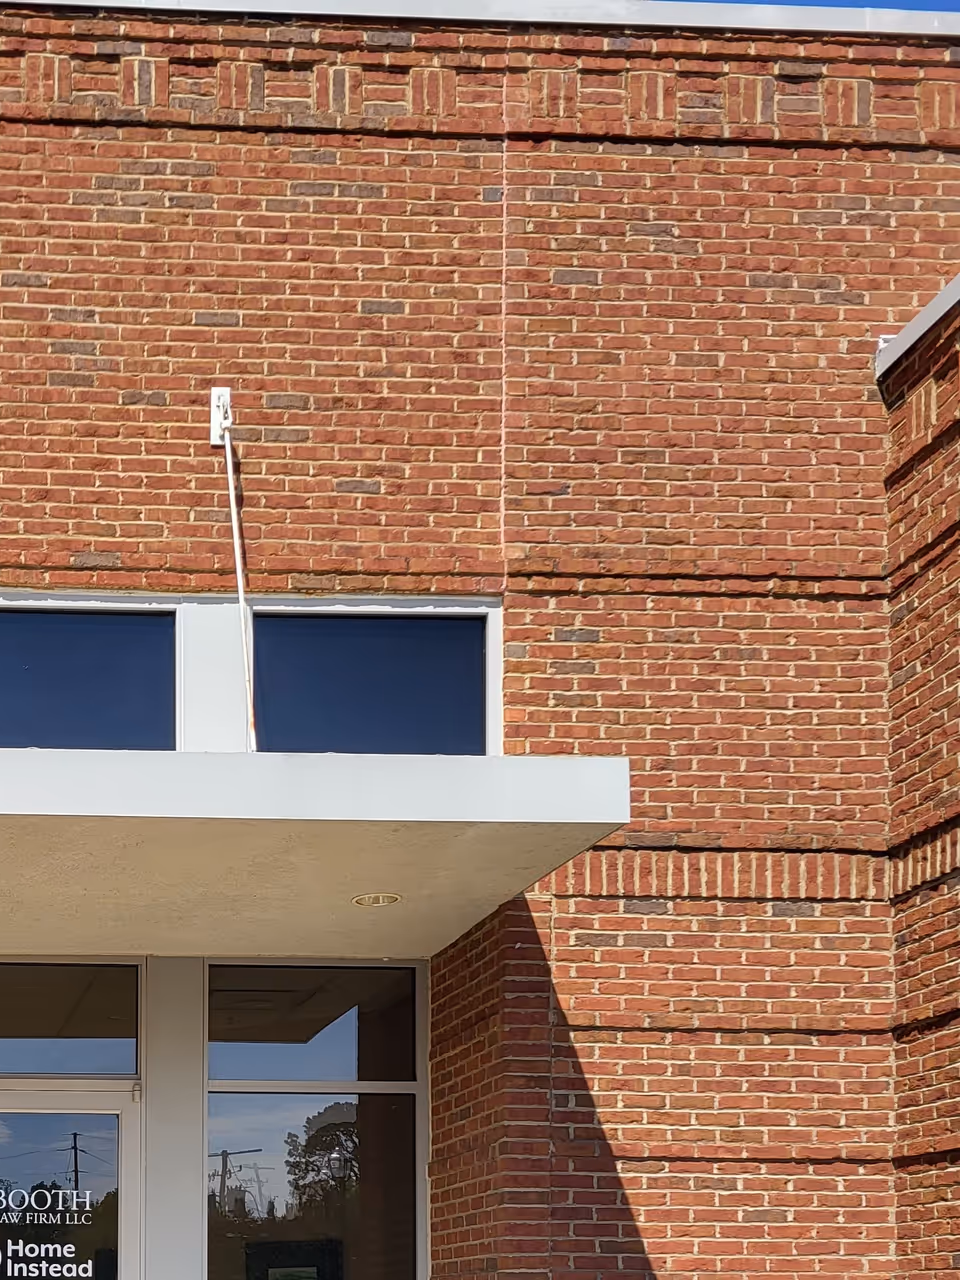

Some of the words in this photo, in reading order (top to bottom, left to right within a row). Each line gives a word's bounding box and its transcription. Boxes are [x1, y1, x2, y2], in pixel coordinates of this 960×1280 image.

[26, 1213, 61, 1224] FIRM
[65, 1213, 92, 1225] LLC
[7, 1239, 75, 1257] Home
[7, 1259, 92, 1277] Instead
